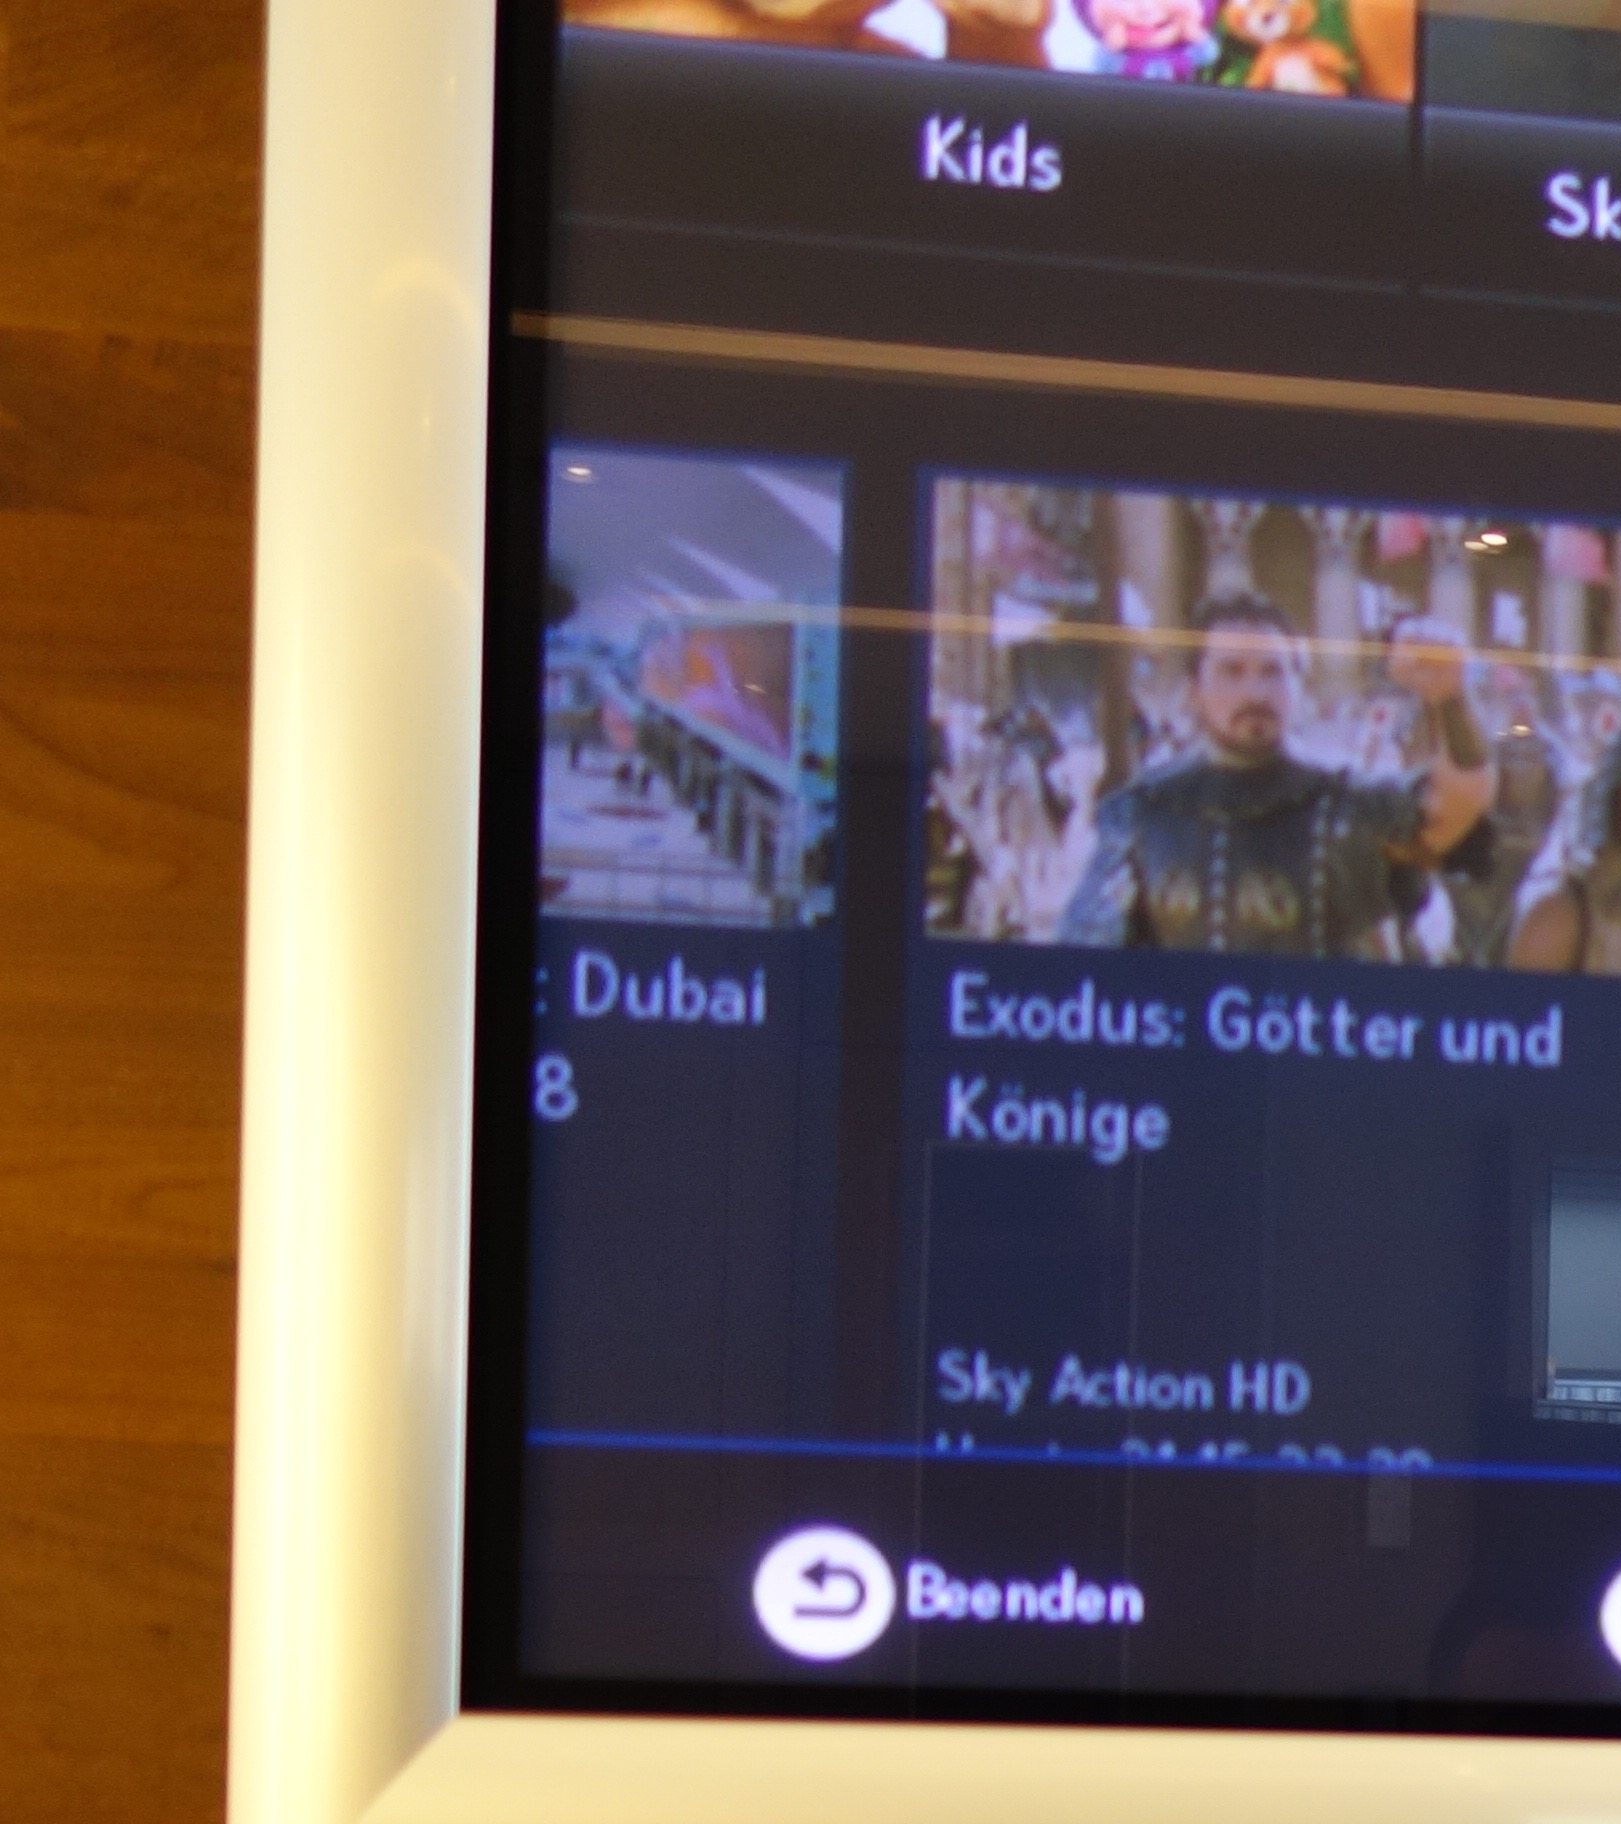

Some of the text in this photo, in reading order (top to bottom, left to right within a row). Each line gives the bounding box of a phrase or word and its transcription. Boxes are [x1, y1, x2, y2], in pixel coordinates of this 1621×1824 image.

[921, 115, 1063, 192] Kids
[572, 946, 768, 1026] Dubai
[949, 968, 1564, 1068] Exodus: Götter und
[533, 1052, 579, 1122] 8
[946, 1073, 1172, 1166] Könige
[937, 1347, 1312, 1417] Sky Action HD
[907, 1560, 1145, 1625] Beenden
